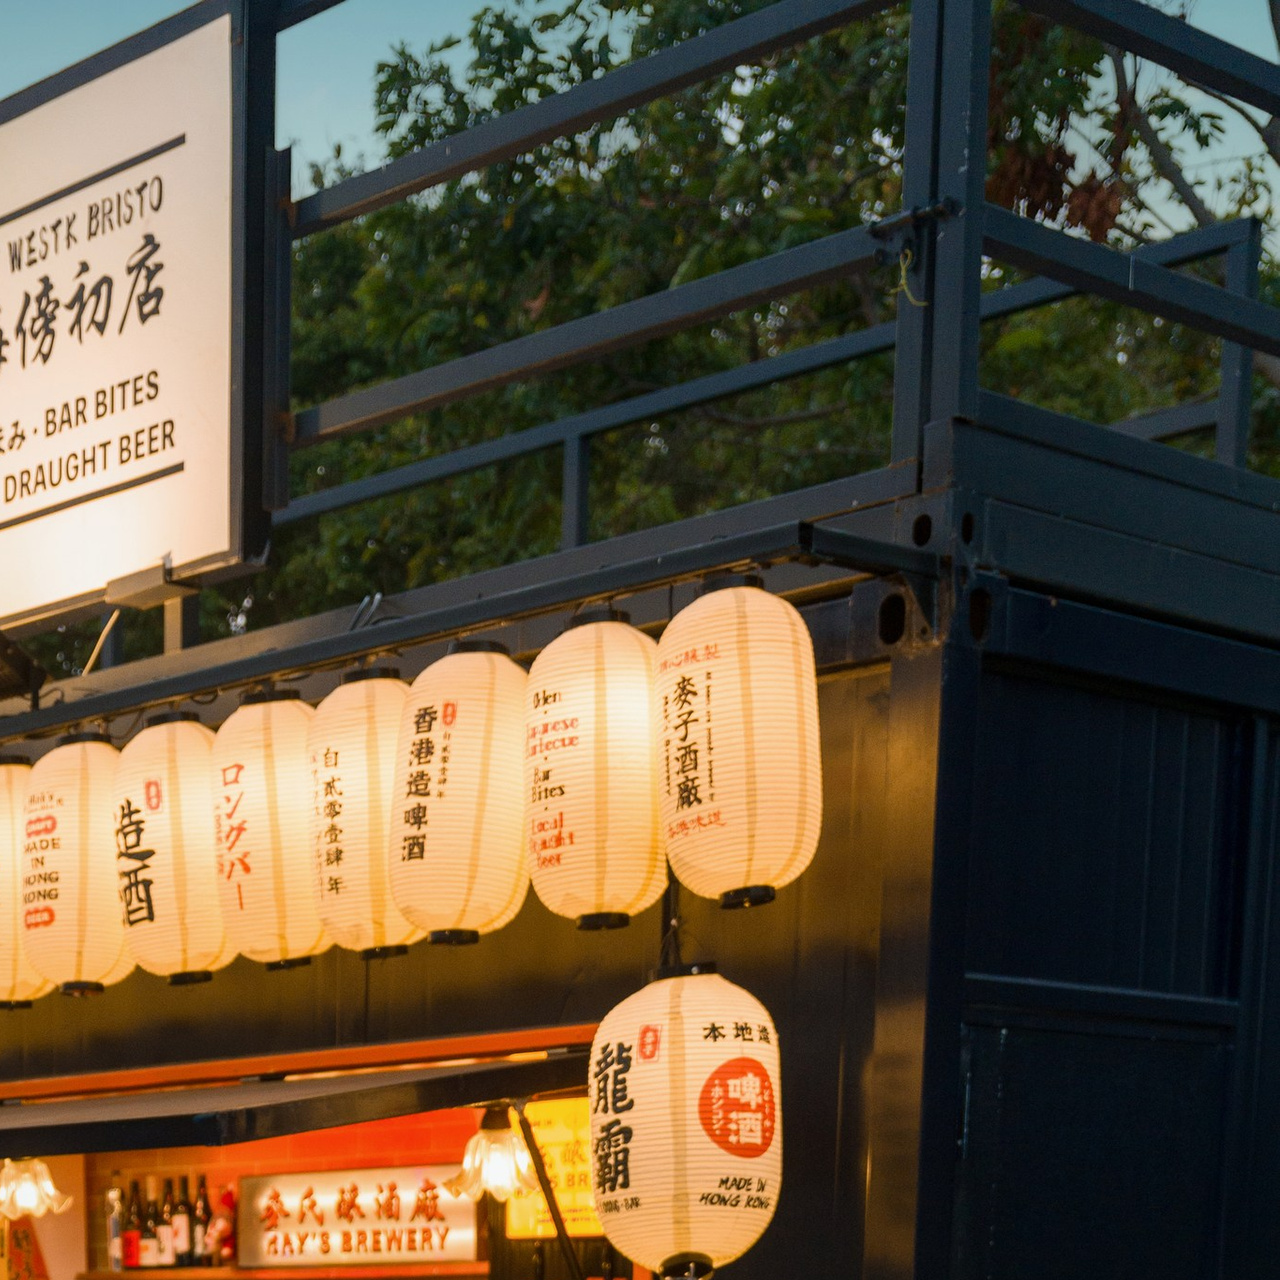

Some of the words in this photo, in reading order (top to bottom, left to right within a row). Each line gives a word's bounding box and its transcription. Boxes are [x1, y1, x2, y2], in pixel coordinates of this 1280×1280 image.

[8, 213, 77, 273] WESTK
[87, 176, 163, 240] BRISTO
[44, 397, 87, 437] BAR
[94, 370, 160, 420] BITES
[4, 440, 112, 504] DRAUGHT
[120, 418, 176, 466] BEER
[402, 705, 438, 861] 香港造啤酒
[593, 1041, 635, 1195] 龍霸
[700, 1192, 740, 1209] HONG
[718, 1176, 752, 1192] MADE
[341, 1226, 450, 1253] BREWERY
